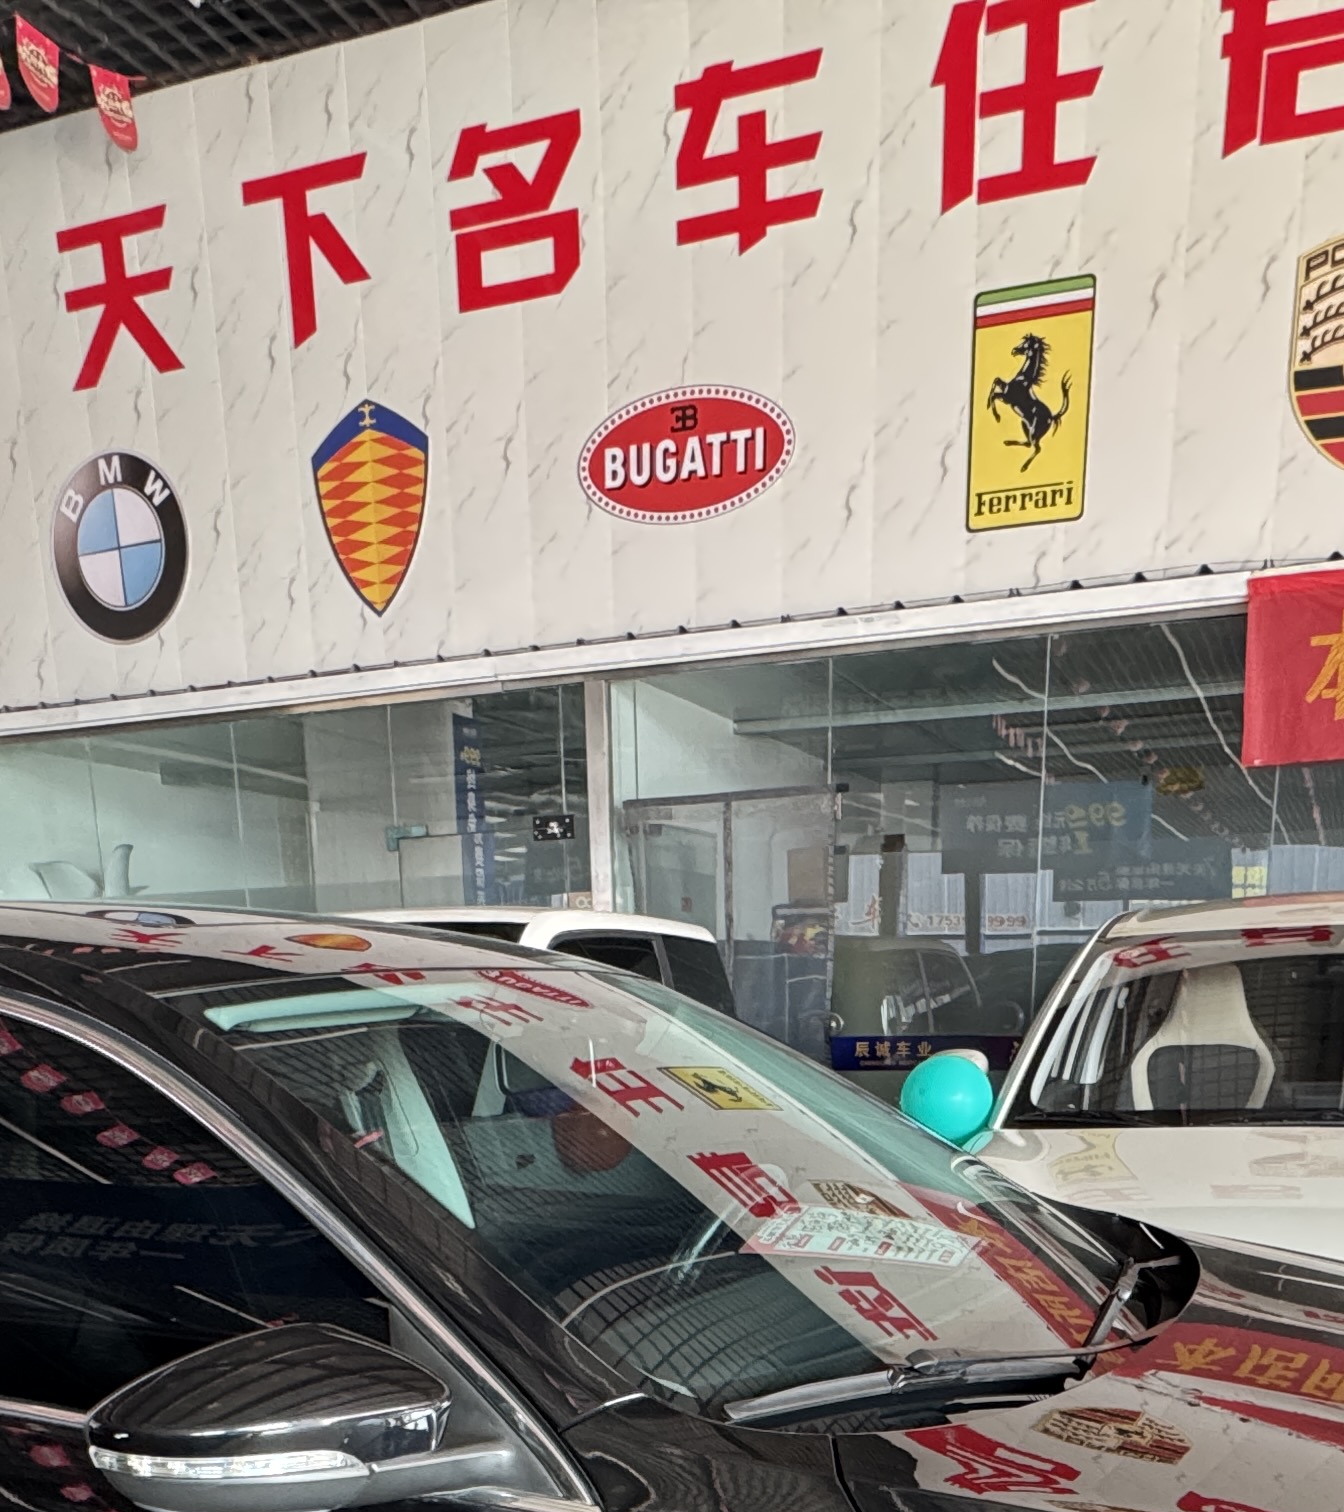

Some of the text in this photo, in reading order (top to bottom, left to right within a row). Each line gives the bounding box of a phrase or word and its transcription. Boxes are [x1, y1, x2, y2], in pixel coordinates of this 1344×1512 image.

[60, 455, 171, 523] BMW
[604, 427, 767, 491] BUGATTI
[974, 480, 1074, 517] Ferrari
